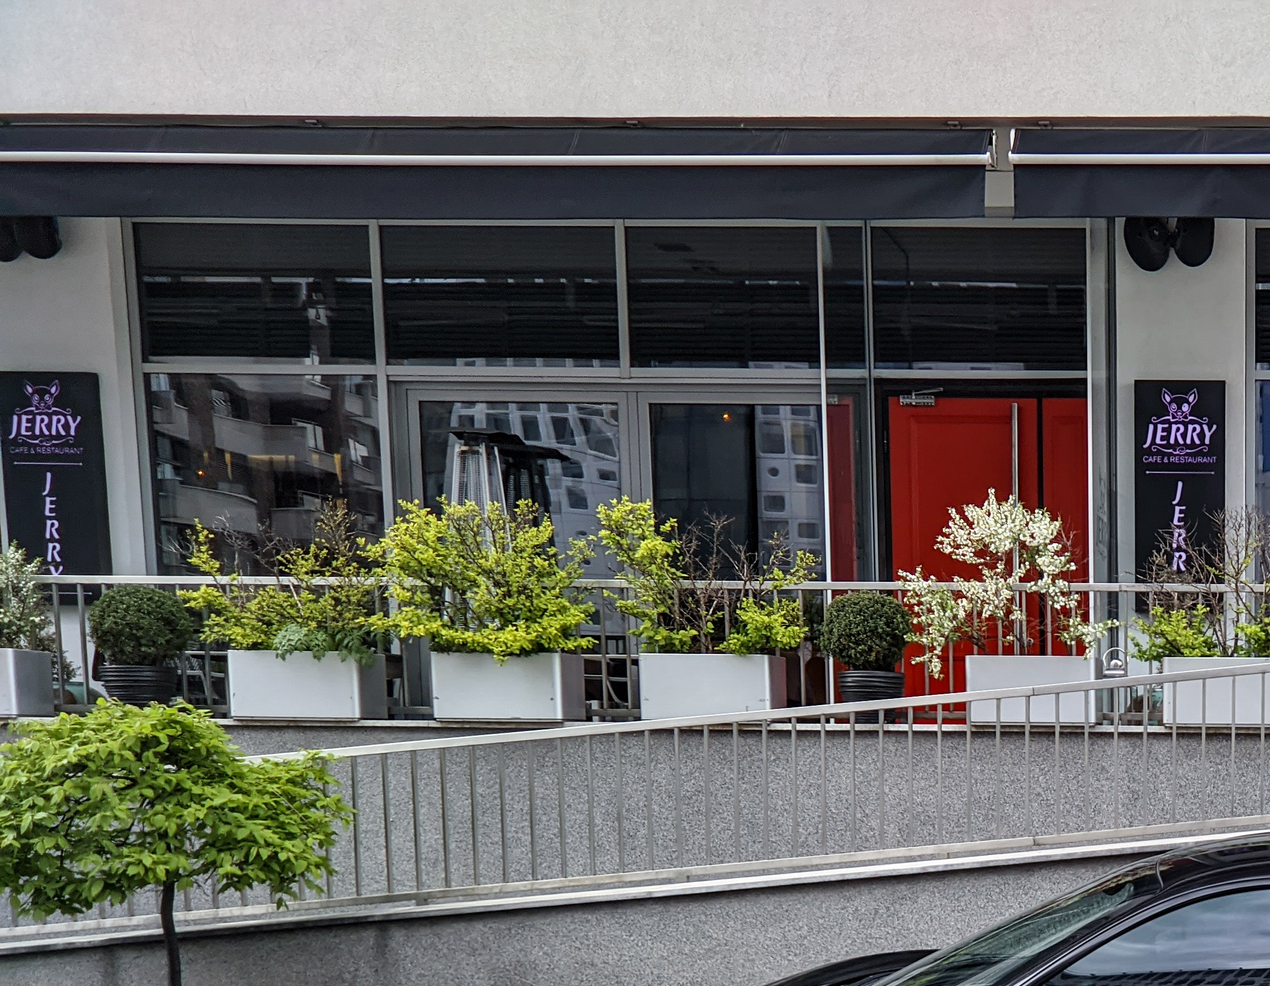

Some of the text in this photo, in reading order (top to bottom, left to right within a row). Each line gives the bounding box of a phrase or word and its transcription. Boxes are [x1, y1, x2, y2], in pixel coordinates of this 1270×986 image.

[9, 414, 82, 439] JERRY
[1143, 423, 1217, 448] JERRY
[37, 446, 84, 455] RESTAURANT
[1142, 455, 1162, 463] CAFE
[1170, 455, 1217, 464] RESTAURANT
[1172, 481, 1187, 572] JERR
